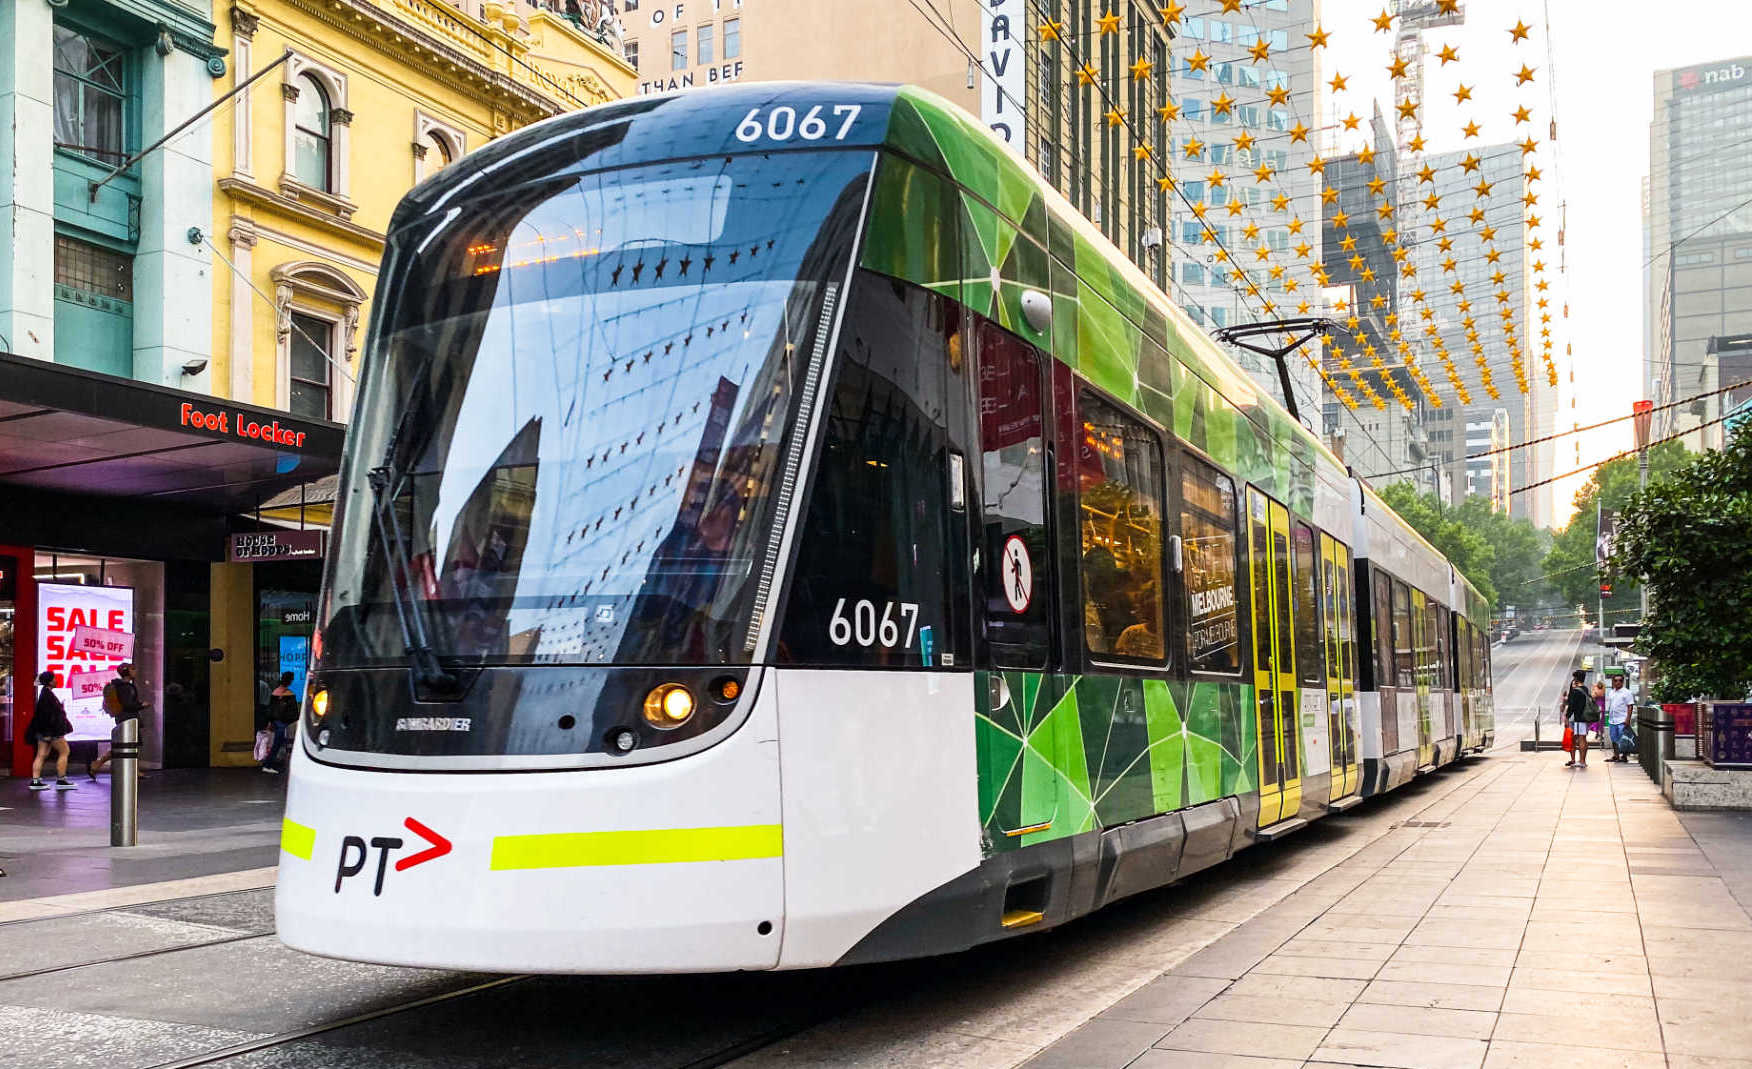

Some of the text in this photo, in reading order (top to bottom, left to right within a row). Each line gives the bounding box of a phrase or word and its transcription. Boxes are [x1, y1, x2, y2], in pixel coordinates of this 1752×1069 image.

[653, 4, 684, 24] OF
[642, 72, 694, 95] THAN
[989, 0, 1012, 143] AVID
[1704, 64, 1745, 84] nab
[735, 103, 862, 142] 6067
[181, 402, 306, 448] Foot Locker
[235, 535, 276, 548] HOUSE
[1191, 585, 1234, 617] MELBOURNE
[47, 606, 125, 632] SALE
[829, 598, 919, 649] 6067
[84, 638, 125, 652] 50% OFF
[396, 717, 471, 732] BOMBARDIER
